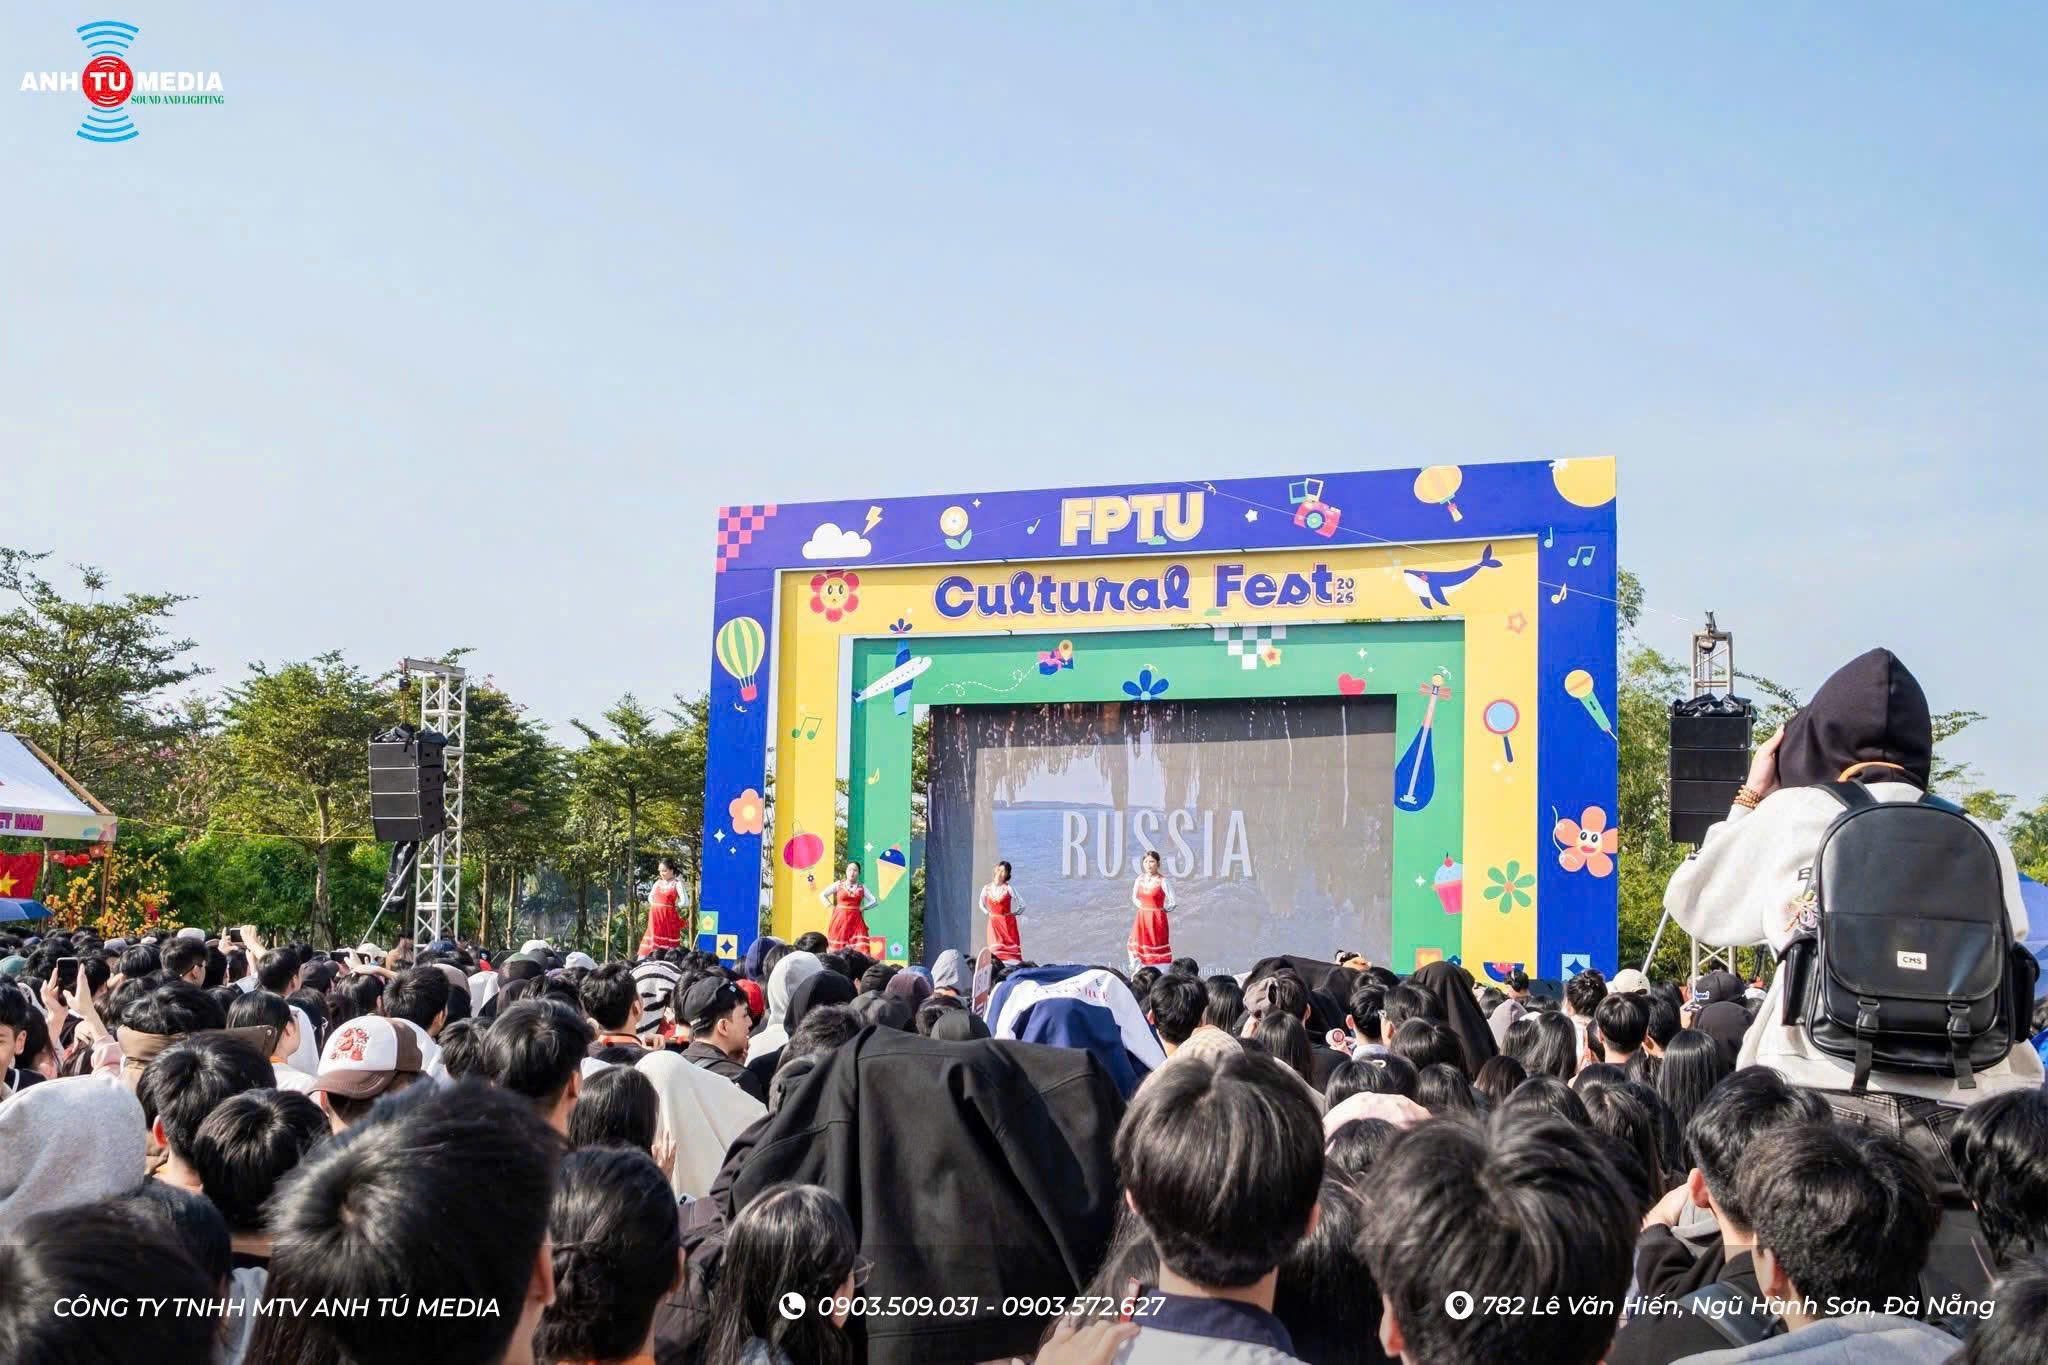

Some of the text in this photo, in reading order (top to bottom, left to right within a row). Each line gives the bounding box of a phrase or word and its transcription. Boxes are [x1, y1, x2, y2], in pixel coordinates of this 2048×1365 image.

[1060, 491, 1205, 546] FPTU
[935, 563, 1333, 618] Cultural Fest
[1062, 809, 1254, 879] RUSSIA
[1902, 956, 1922, 965] CMS
